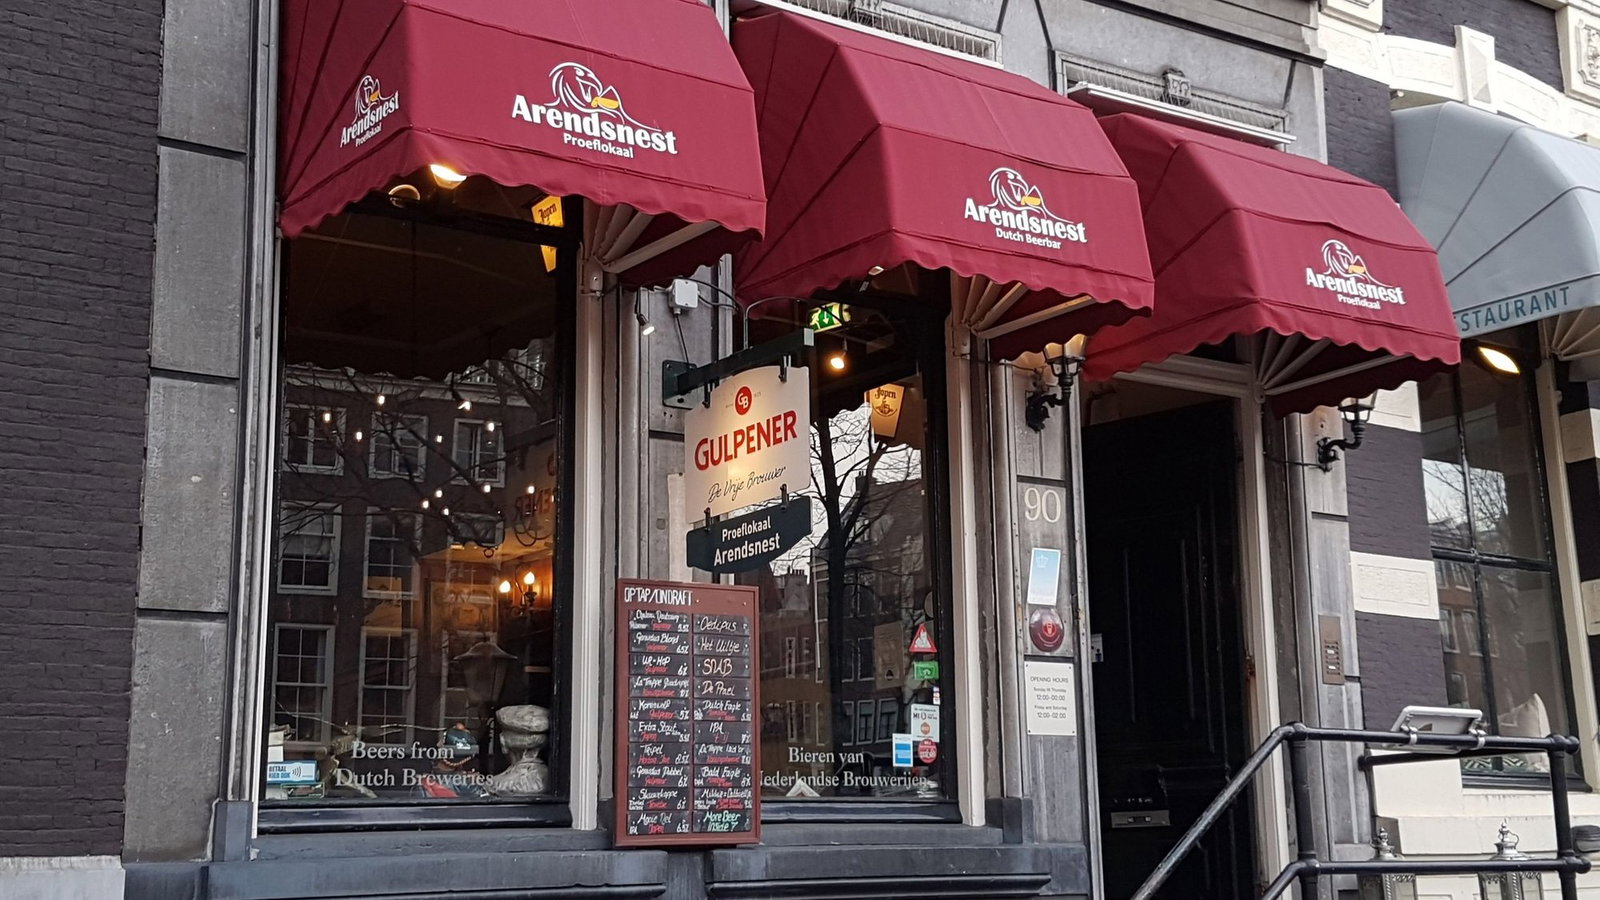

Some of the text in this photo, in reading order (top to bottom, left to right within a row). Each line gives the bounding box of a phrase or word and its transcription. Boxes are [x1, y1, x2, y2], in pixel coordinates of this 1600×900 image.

[340, 90, 400, 148] Arendsnest
[511, 94, 678, 155] Arendsnest
[355, 122, 382, 148] Proeflokaal
[563, 132, 634, 159] Proeflokaal
[964, 197, 1088, 243] Arendsnest
[996, 227, 1062, 249] Dutch Beerbar
[1306, 267, 1406, 305] Arendsnest
[1337, 293, 1381, 310] Proeflokaal
[1453, 286, 1570, 332] STAURANT
[694, 410, 798, 471] GULPENER
[708, 466, 787, 503] De Vrije Brouwer
[1024, 487, 1061, 523] 90
[722, 515, 771, 542] Proeflokaal
[714, 533, 780, 567] Arendsnest
[700, 616, 737, 632] Oedipus
[700, 636, 740, 656] Het Uiltje
[702, 681, 714, 695] De
[702, 700, 723, 710] Dutch
[639, 721, 677, 733] Extra Stout
[710, 722, 724, 734] IPA
[352, 741, 405, 760] Beers
[409, 741, 456, 760] from
[640, 743, 664, 756] Tripel
[788, 746, 864, 763] Bieren van
[335, 768, 494, 787] Dutch Breweries
[701, 766, 721, 777] Bald
[760, 771, 928, 790] ederlandse Brouwerijen
[703, 810, 741, 822] More Beer
